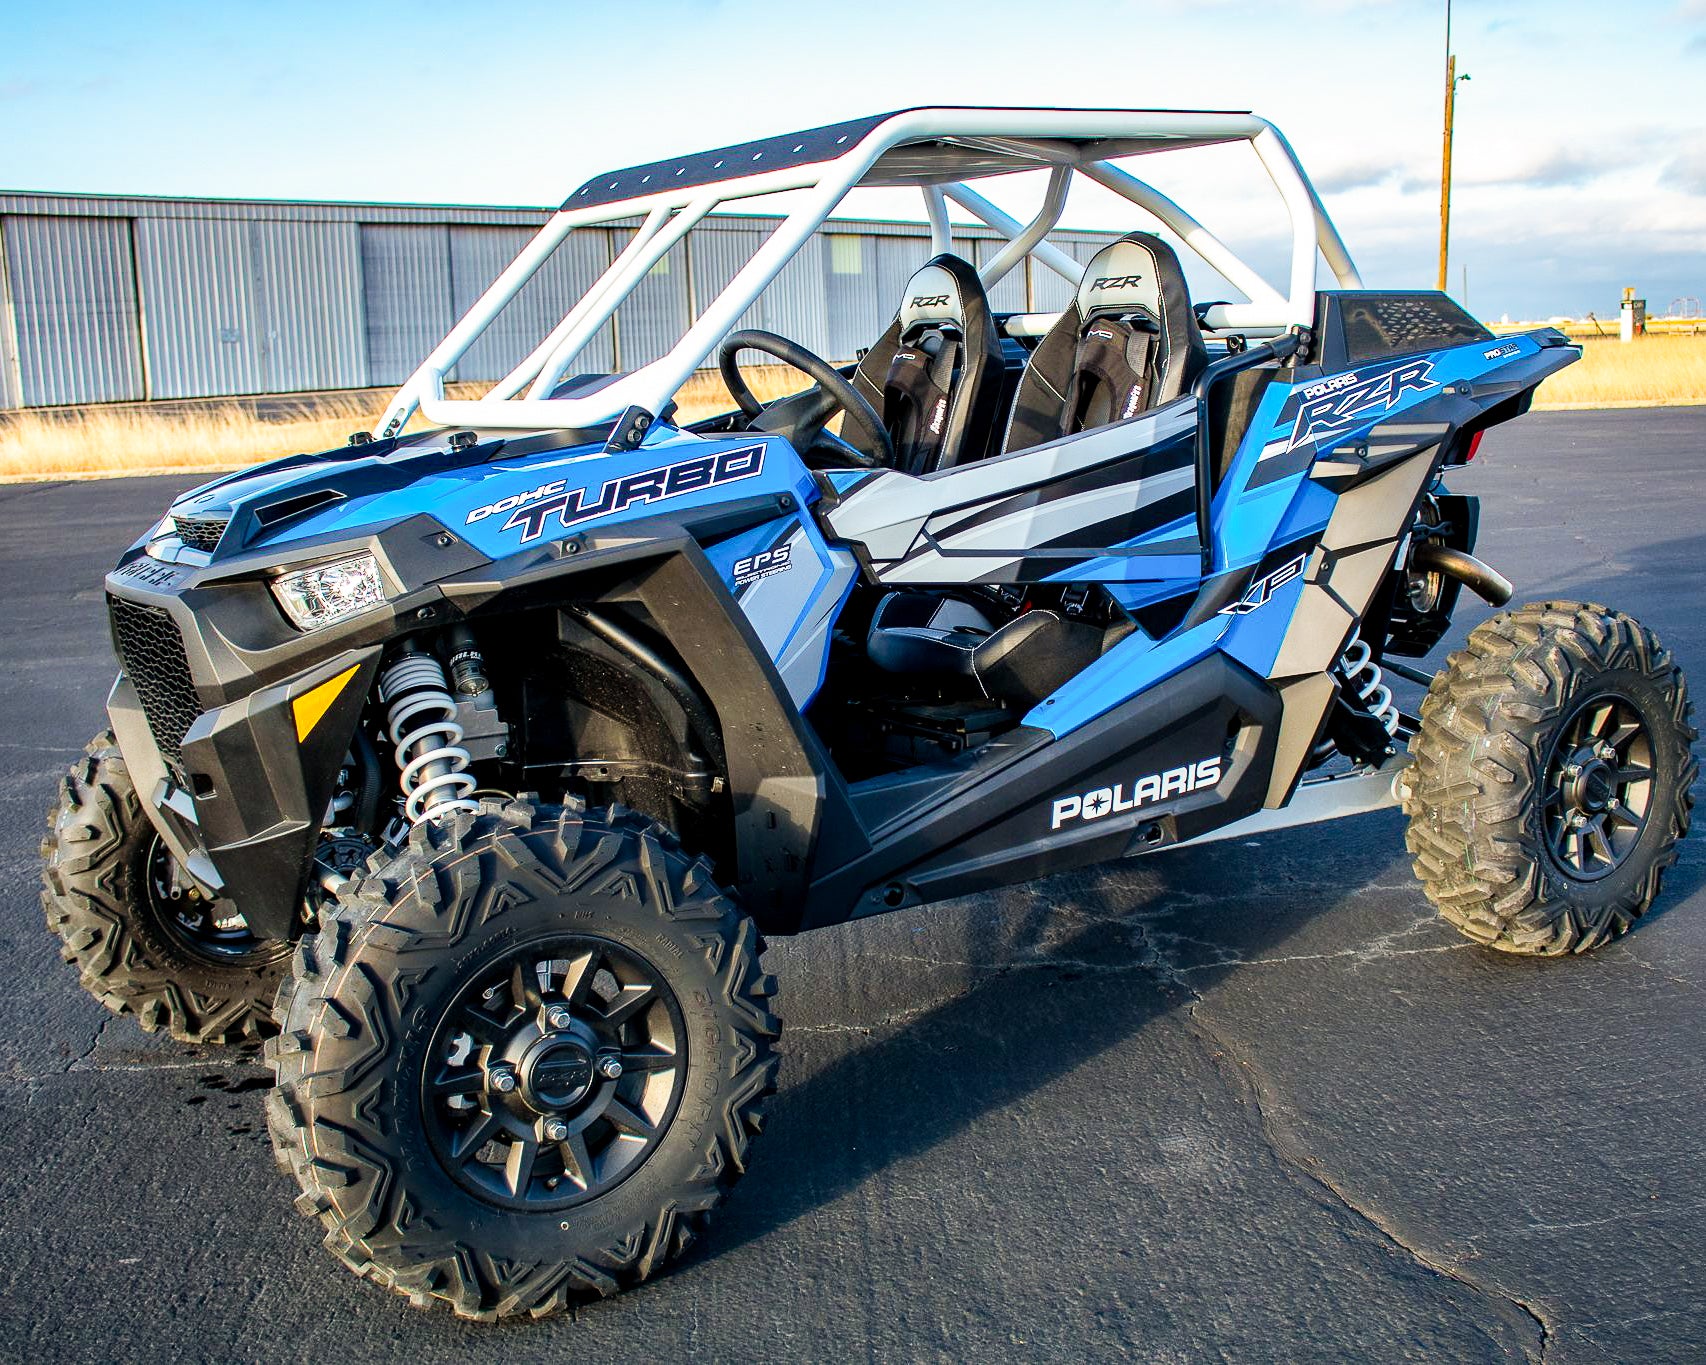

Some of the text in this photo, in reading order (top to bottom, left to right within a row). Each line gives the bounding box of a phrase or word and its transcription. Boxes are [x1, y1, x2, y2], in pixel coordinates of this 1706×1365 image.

[909, 294, 950, 309] RZR
[1089, 275, 1142, 293] RZR
[1286, 359, 1441, 454] RZR
[1303, 372, 1358, 400] POLARIS
[465, 479, 568, 525] DOHC
[500, 442, 768, 544] TURBO
[733, 545, 790, 576] EPS
[1217, 552, 1306, 614] XP
[1051, 756, 1221, 829] POLARIS
